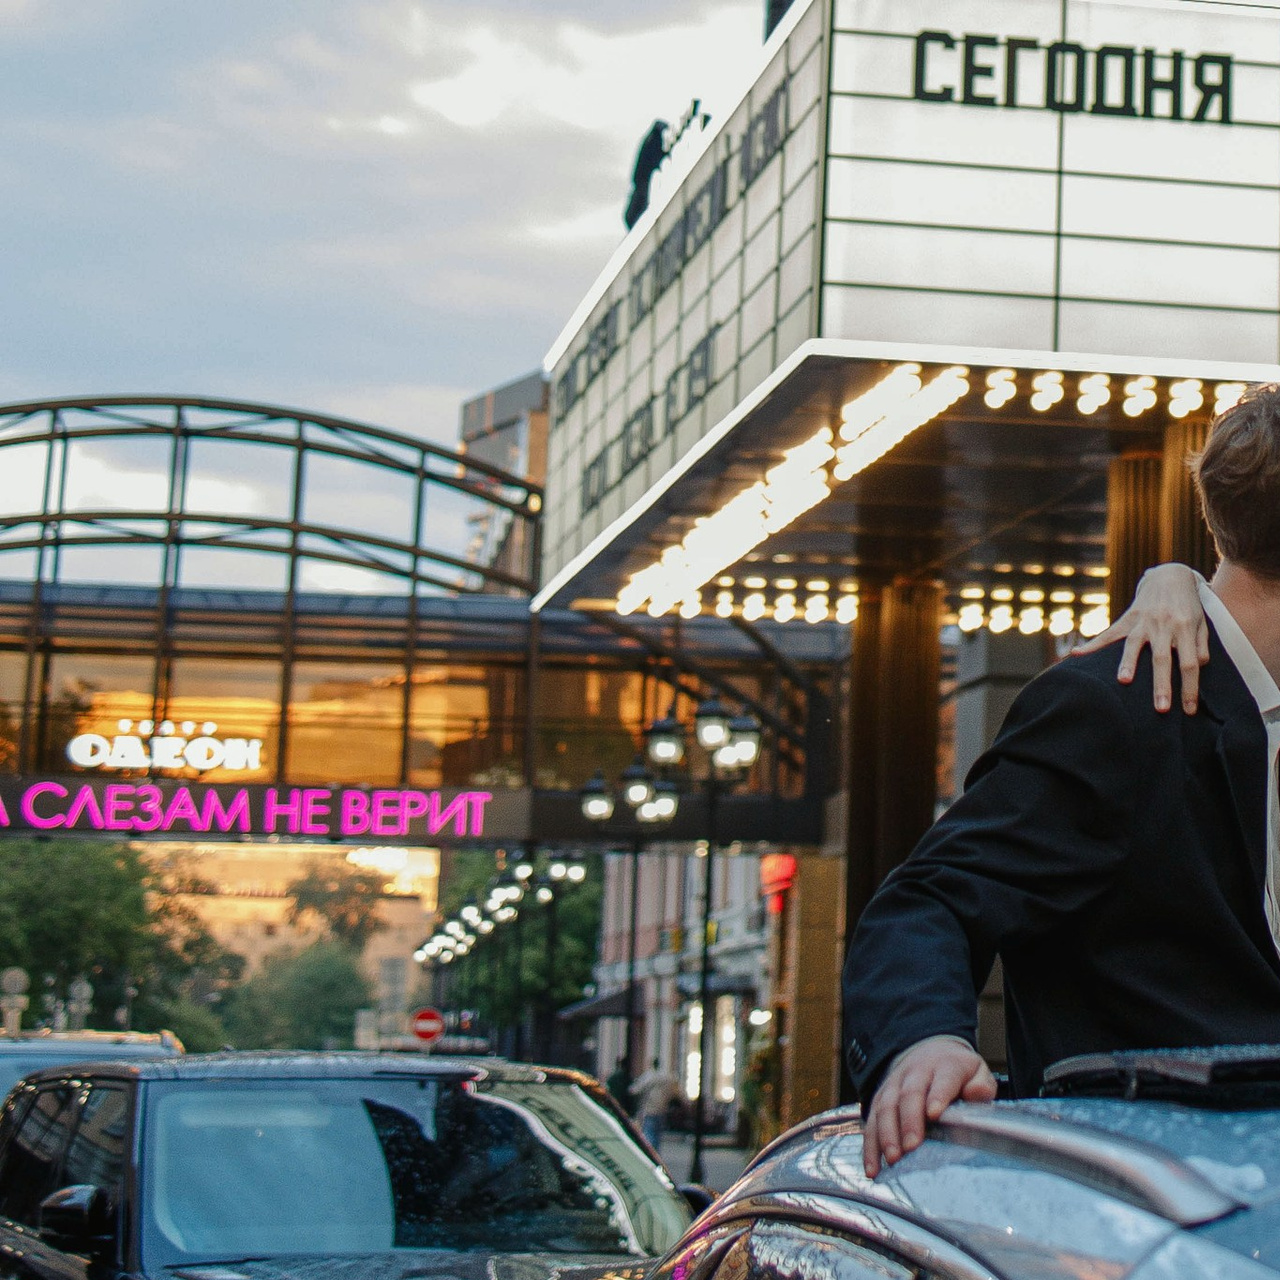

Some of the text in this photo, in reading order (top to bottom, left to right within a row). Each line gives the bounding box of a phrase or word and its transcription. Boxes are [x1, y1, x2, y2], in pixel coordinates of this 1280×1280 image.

[912, 30, 1234, 125] СЕГОДНЯ
[20, 781, 252, 833] СЛЕЗАМ
[264, 786, 331, 835] НЕ
[340, 787, 494, 838] ВЕРИТ
